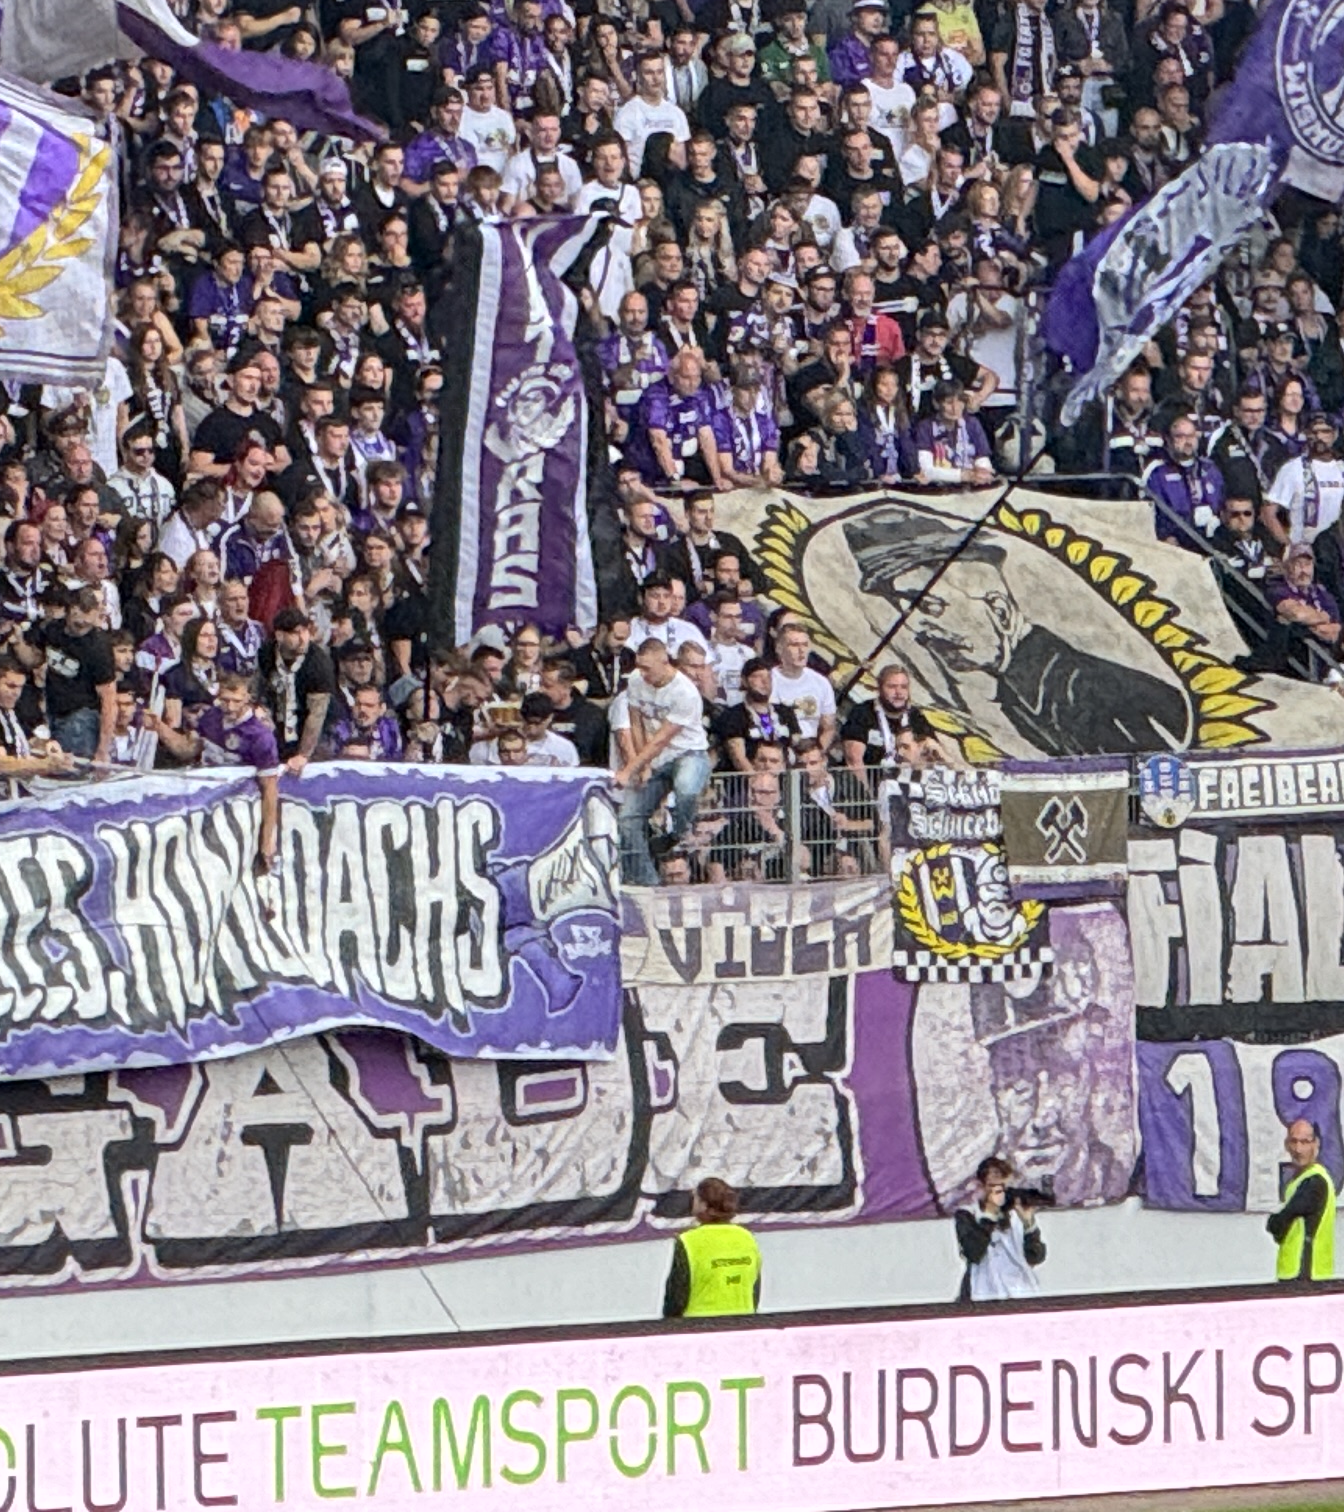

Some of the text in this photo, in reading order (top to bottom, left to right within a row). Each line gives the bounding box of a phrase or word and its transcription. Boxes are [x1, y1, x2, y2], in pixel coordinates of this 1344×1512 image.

[907, 802, 1004, 843] Schneeb
[256, 1376, 766, 1507] TEAMSPORT
[791, 1348, 1226, 1468] BURDENSKI
